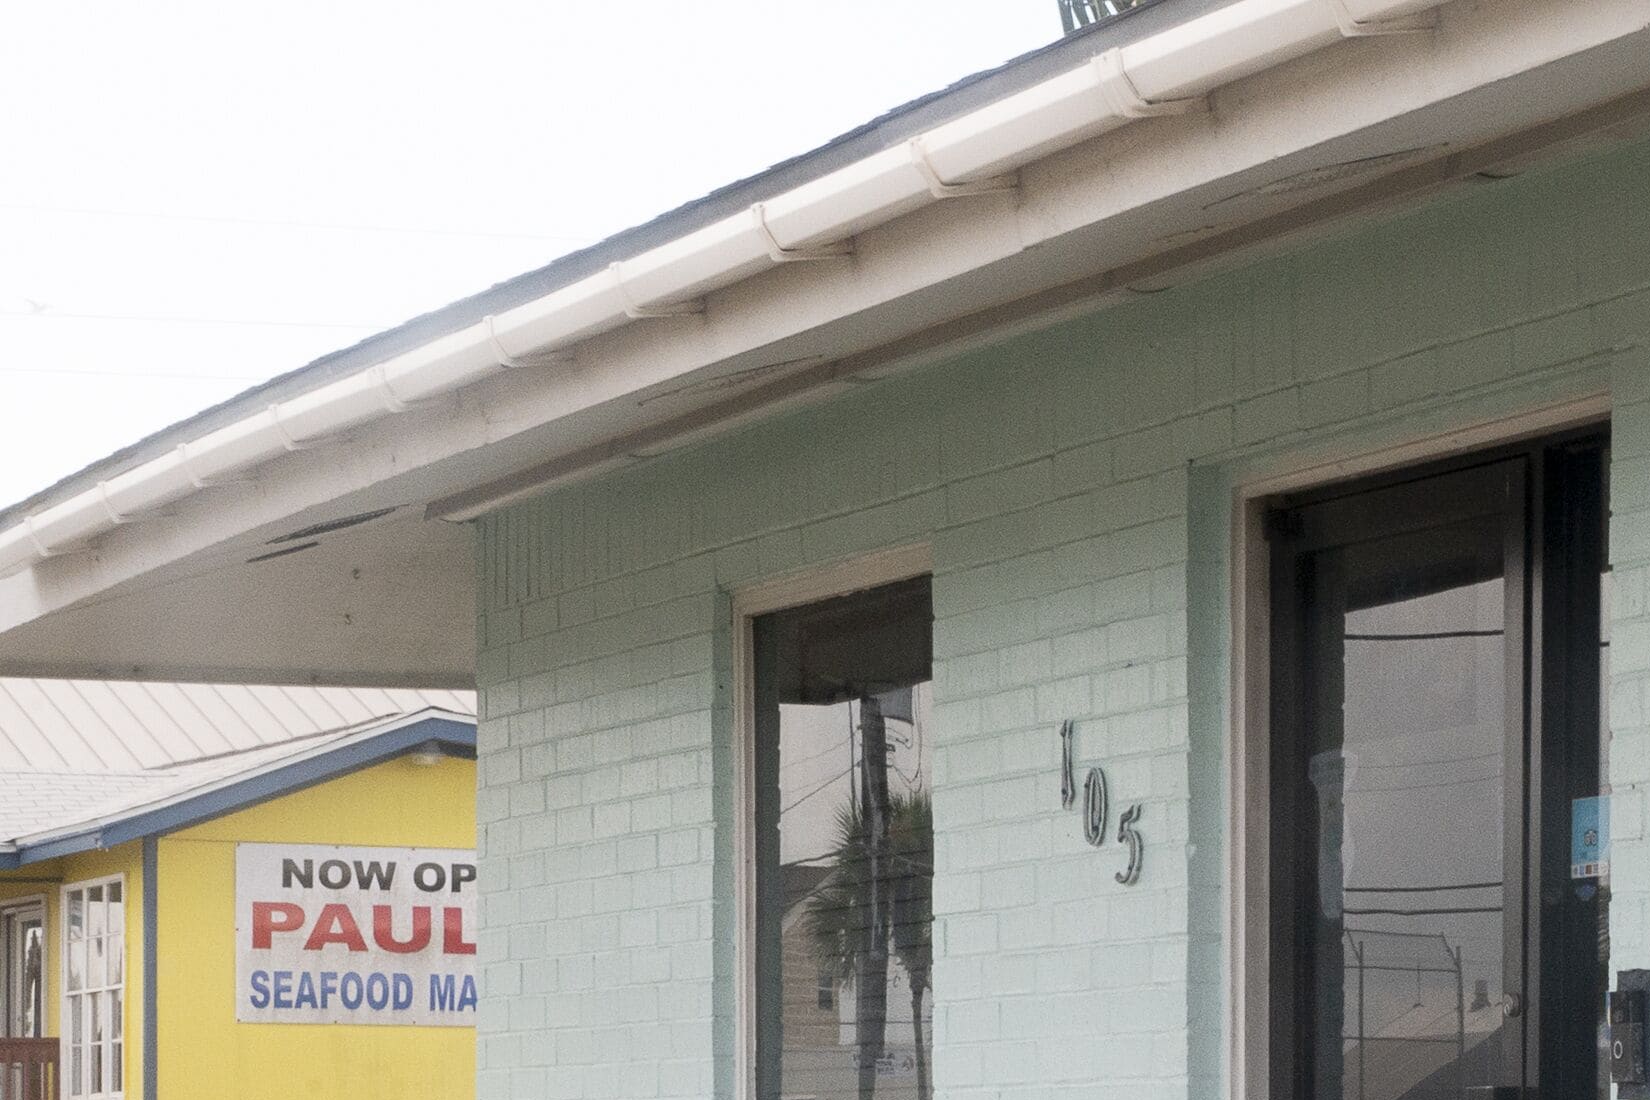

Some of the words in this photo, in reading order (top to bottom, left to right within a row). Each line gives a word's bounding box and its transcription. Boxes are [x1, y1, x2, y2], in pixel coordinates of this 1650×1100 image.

[1060, 719, 1144, 887] 105
[282, 858, 396, 890] NOW
[413, 862, 477, 893] OP
[252, 901, 477, 955] PAUL
[250, 970, 413, 1011] SEAFOOD
[430, 974, 477, 1012] MA
